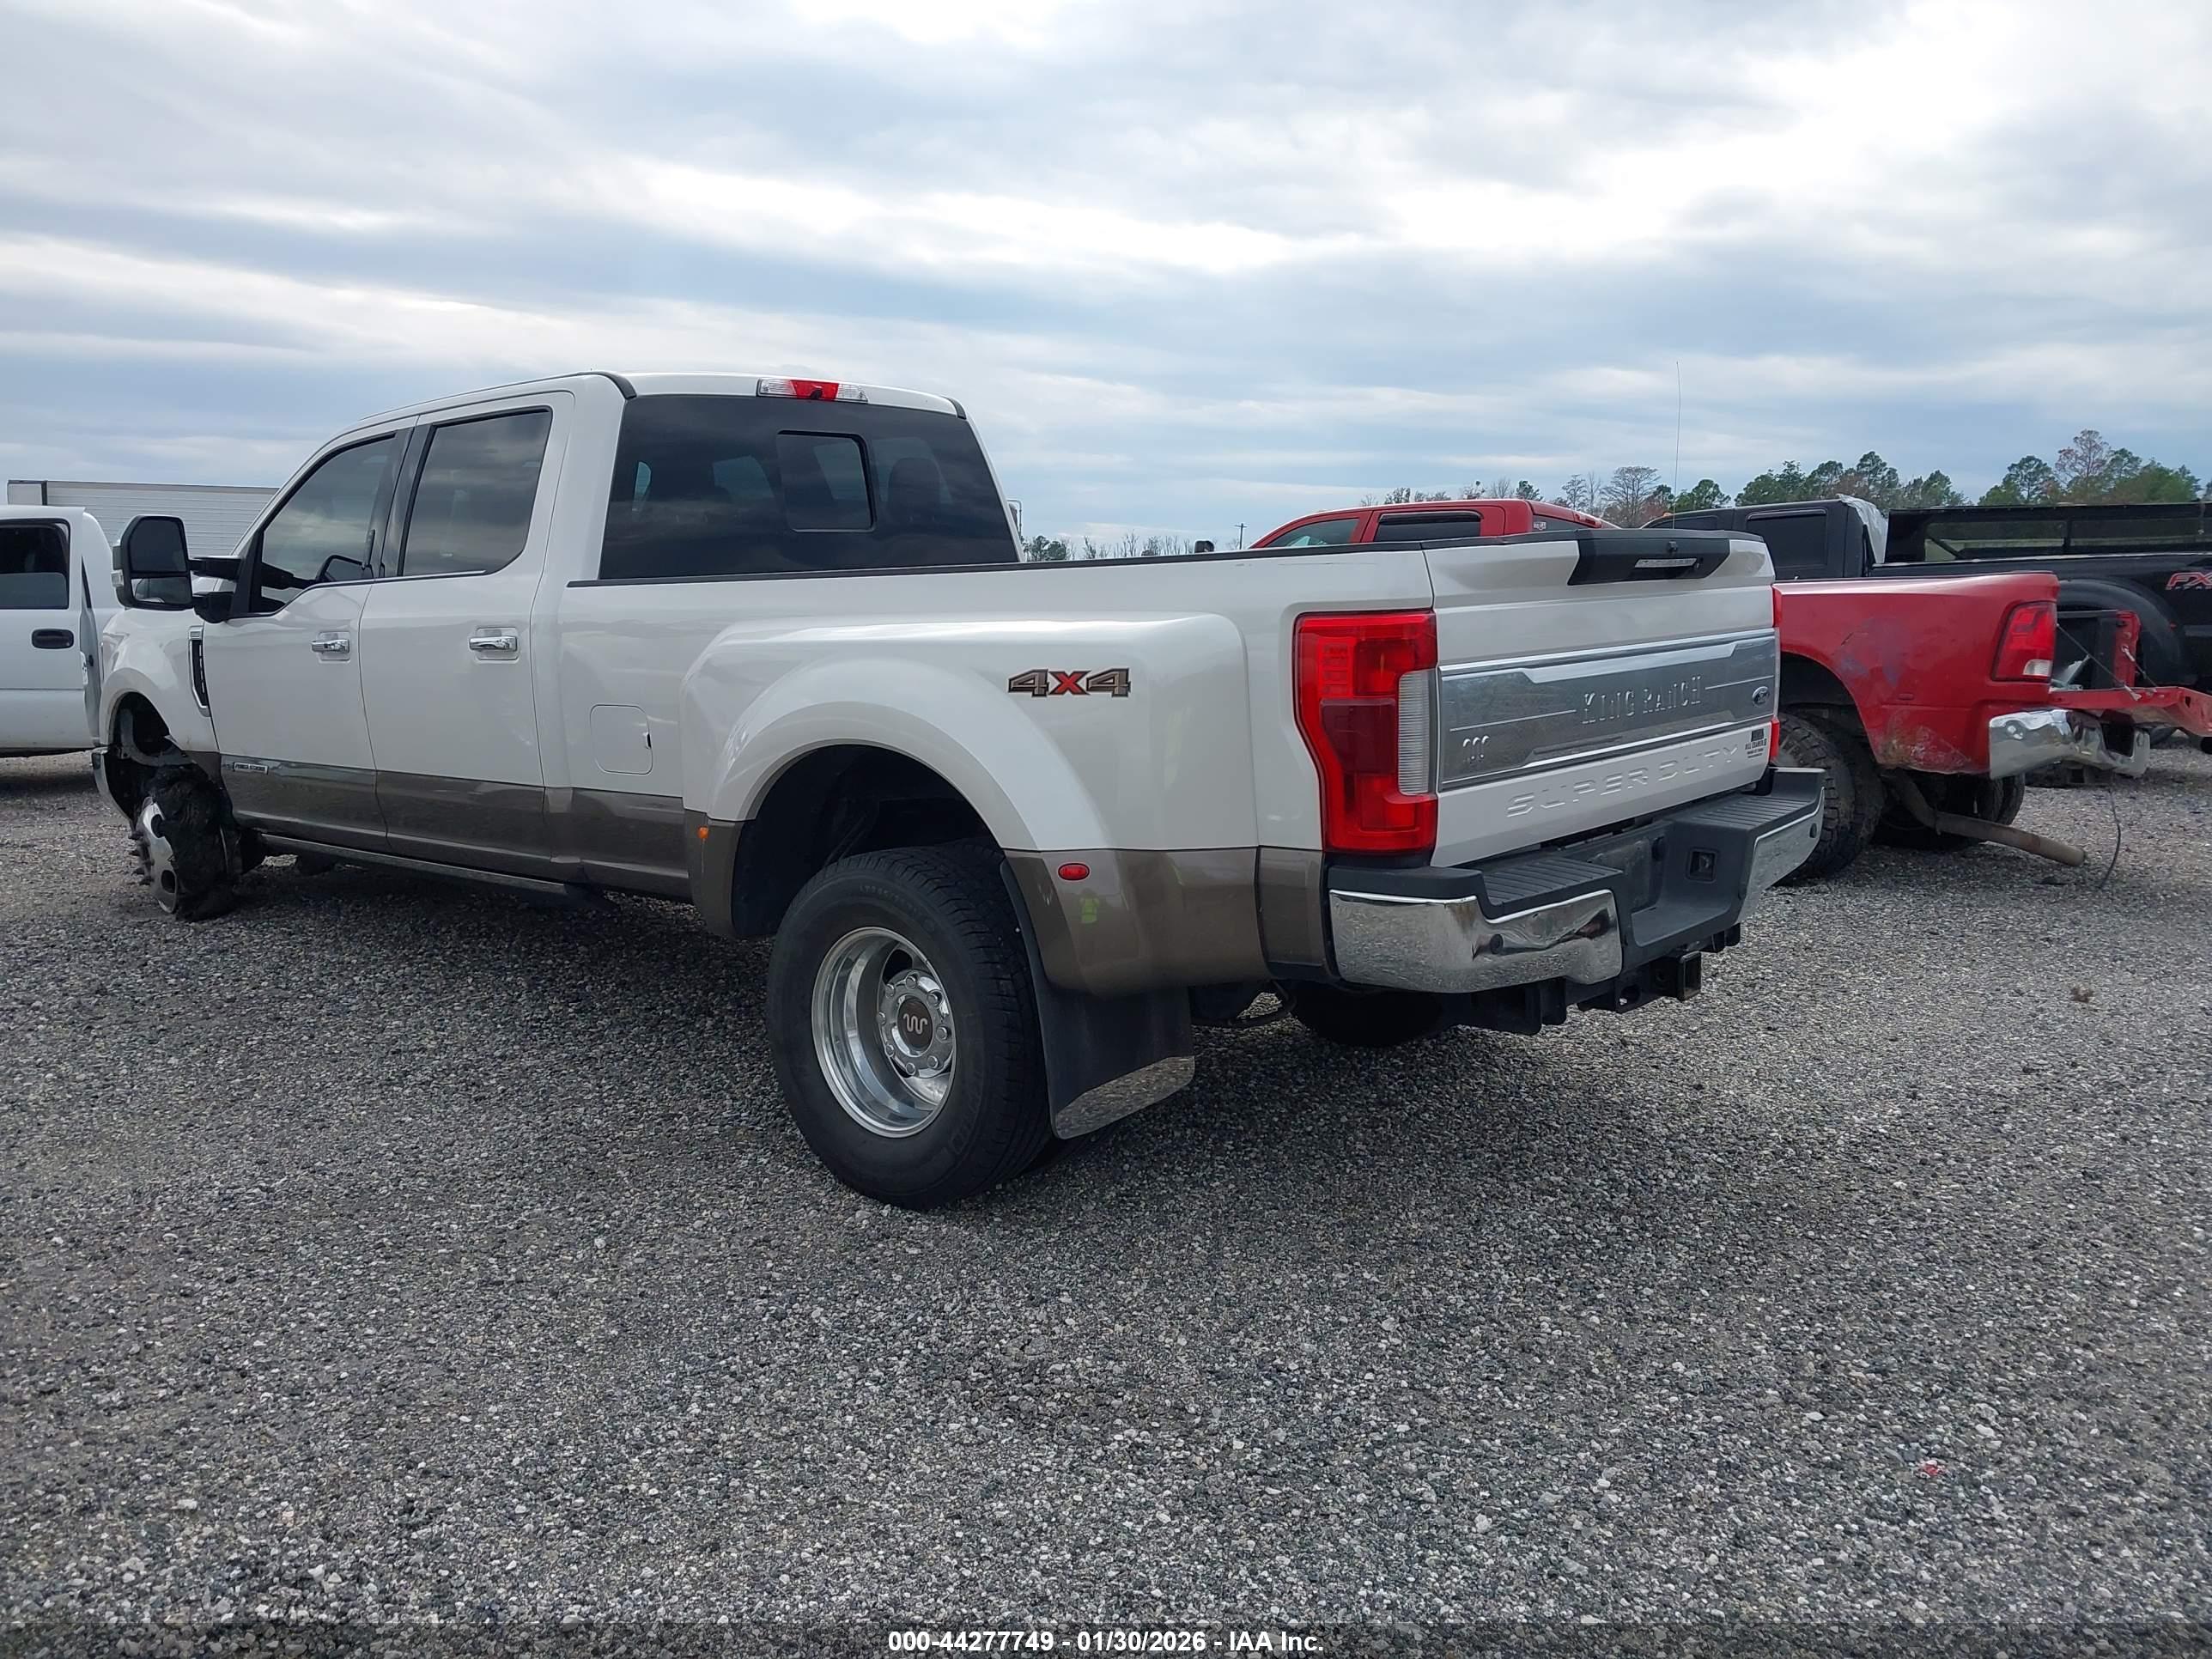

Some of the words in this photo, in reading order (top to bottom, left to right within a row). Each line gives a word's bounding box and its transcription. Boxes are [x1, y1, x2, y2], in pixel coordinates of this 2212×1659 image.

[1582, 690, 1635, 724] KING
[1643, 676, 1701, 714] RANCH
[1506, 768, 1649, 817] SUPER
[1658, 744, 1738, 781] DUTY
